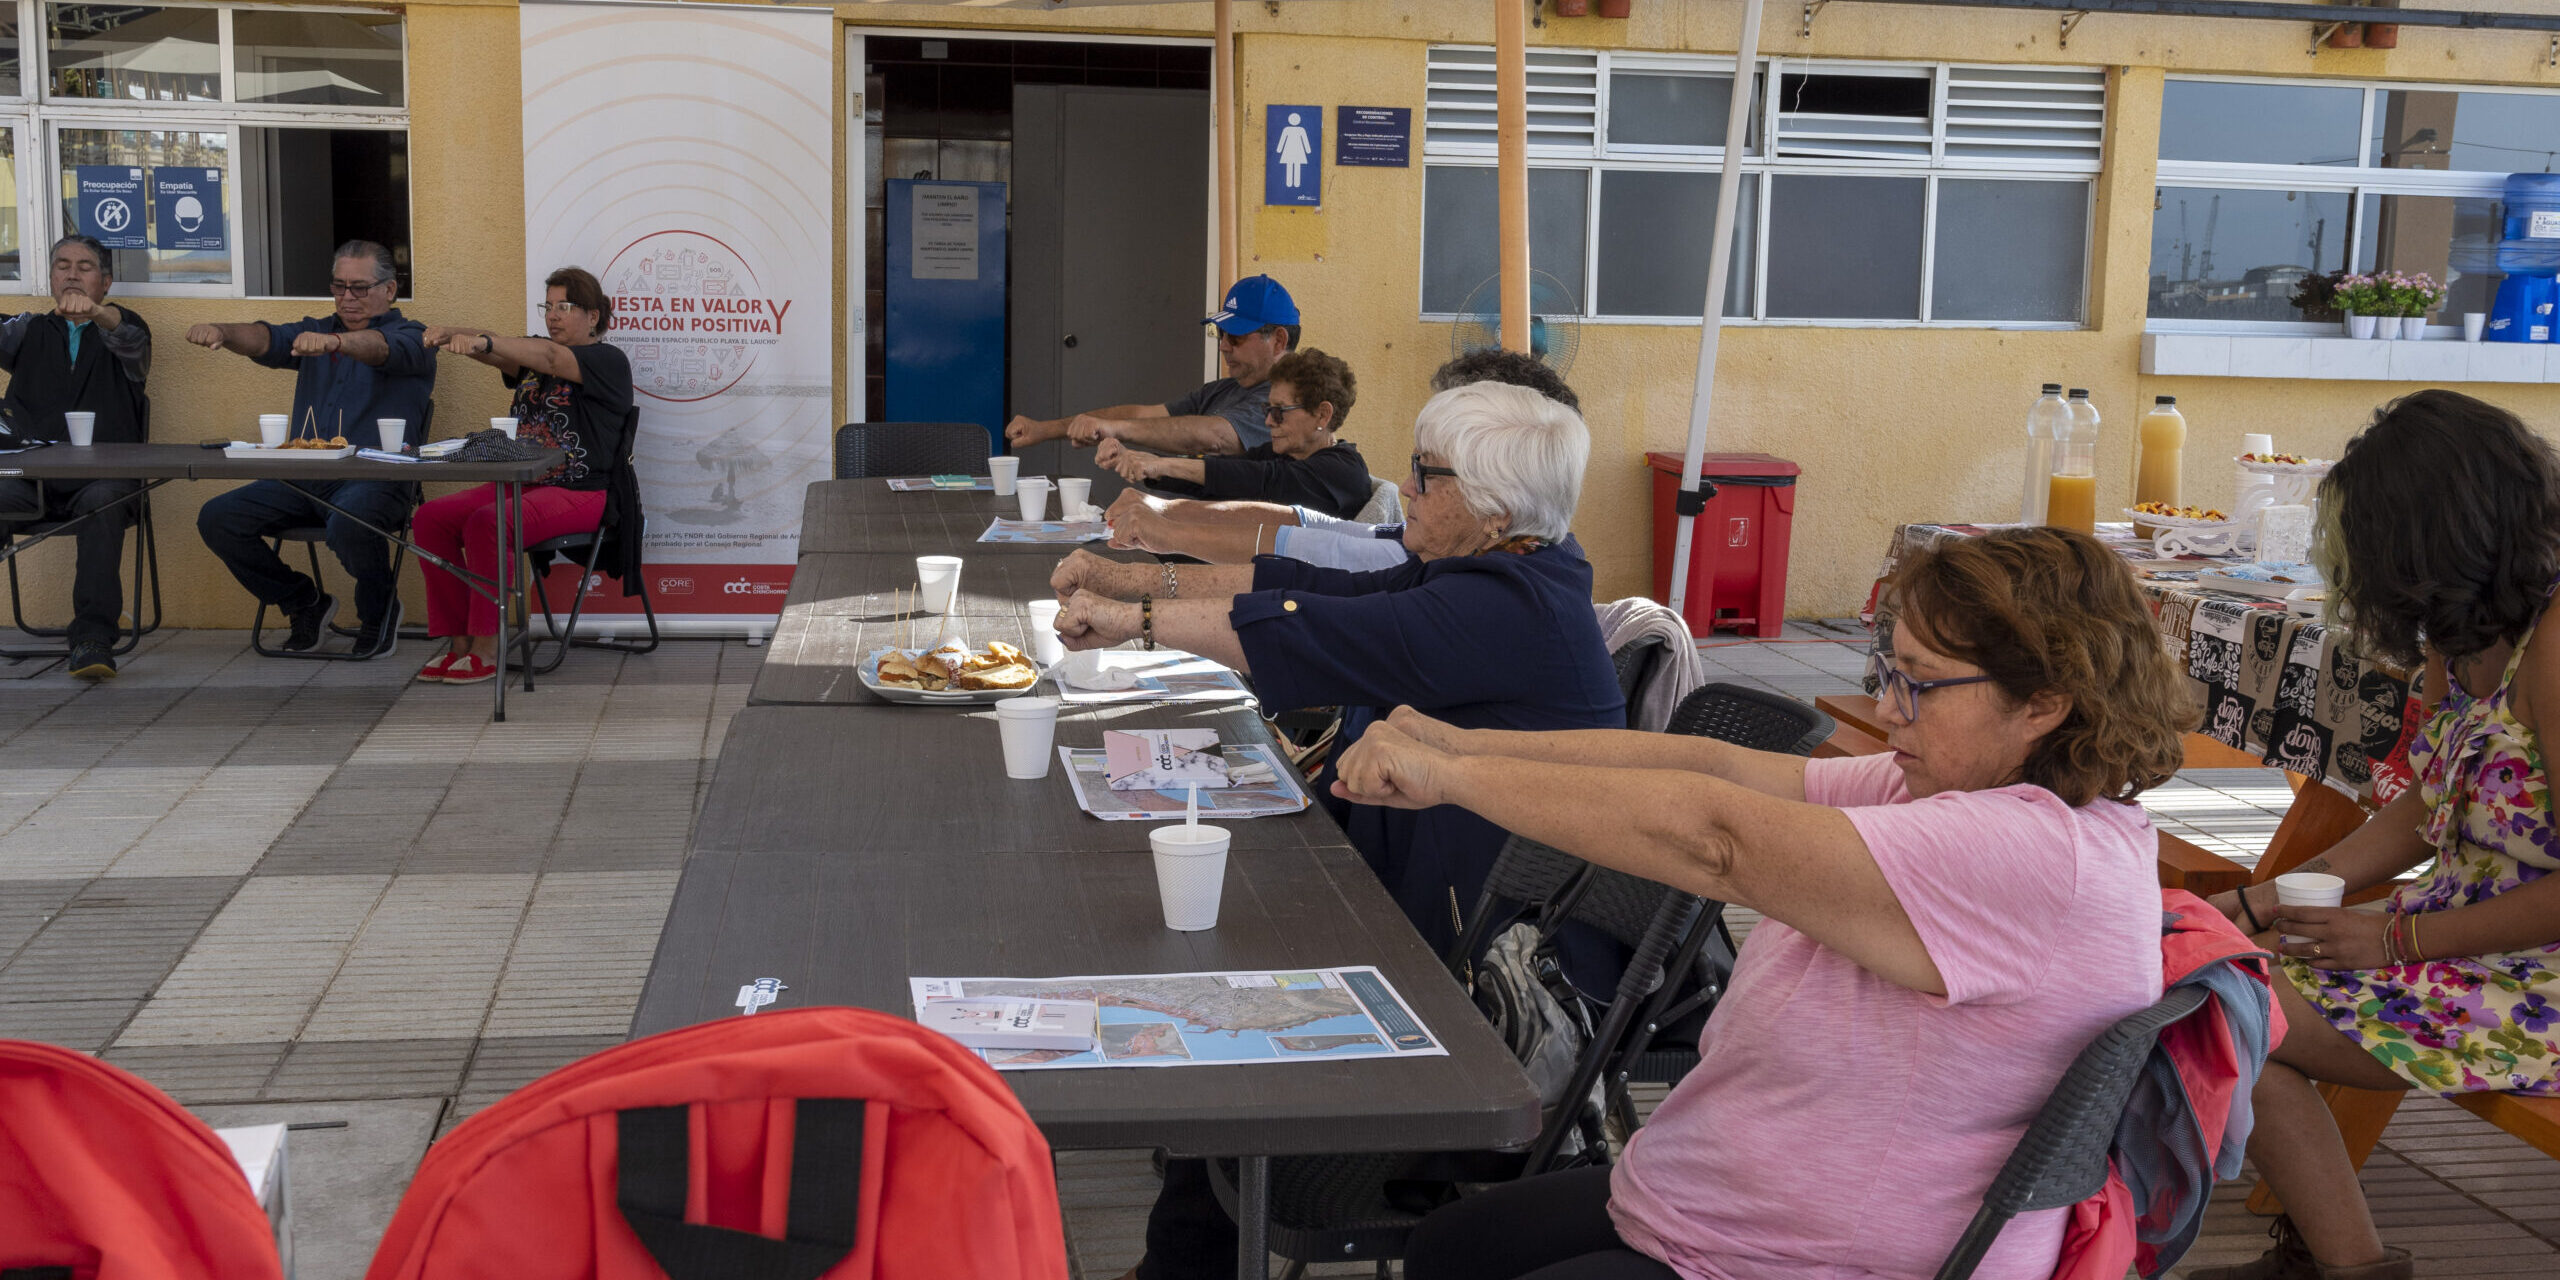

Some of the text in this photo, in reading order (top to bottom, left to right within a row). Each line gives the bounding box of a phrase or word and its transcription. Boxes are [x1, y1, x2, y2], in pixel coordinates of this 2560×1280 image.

[83, 180, 137, 189] Preocupación
[607, 313, 772, 333] UPACIÓN POSITIVA
[611, 296, 792, 335] UESTA EN VALOR Y
